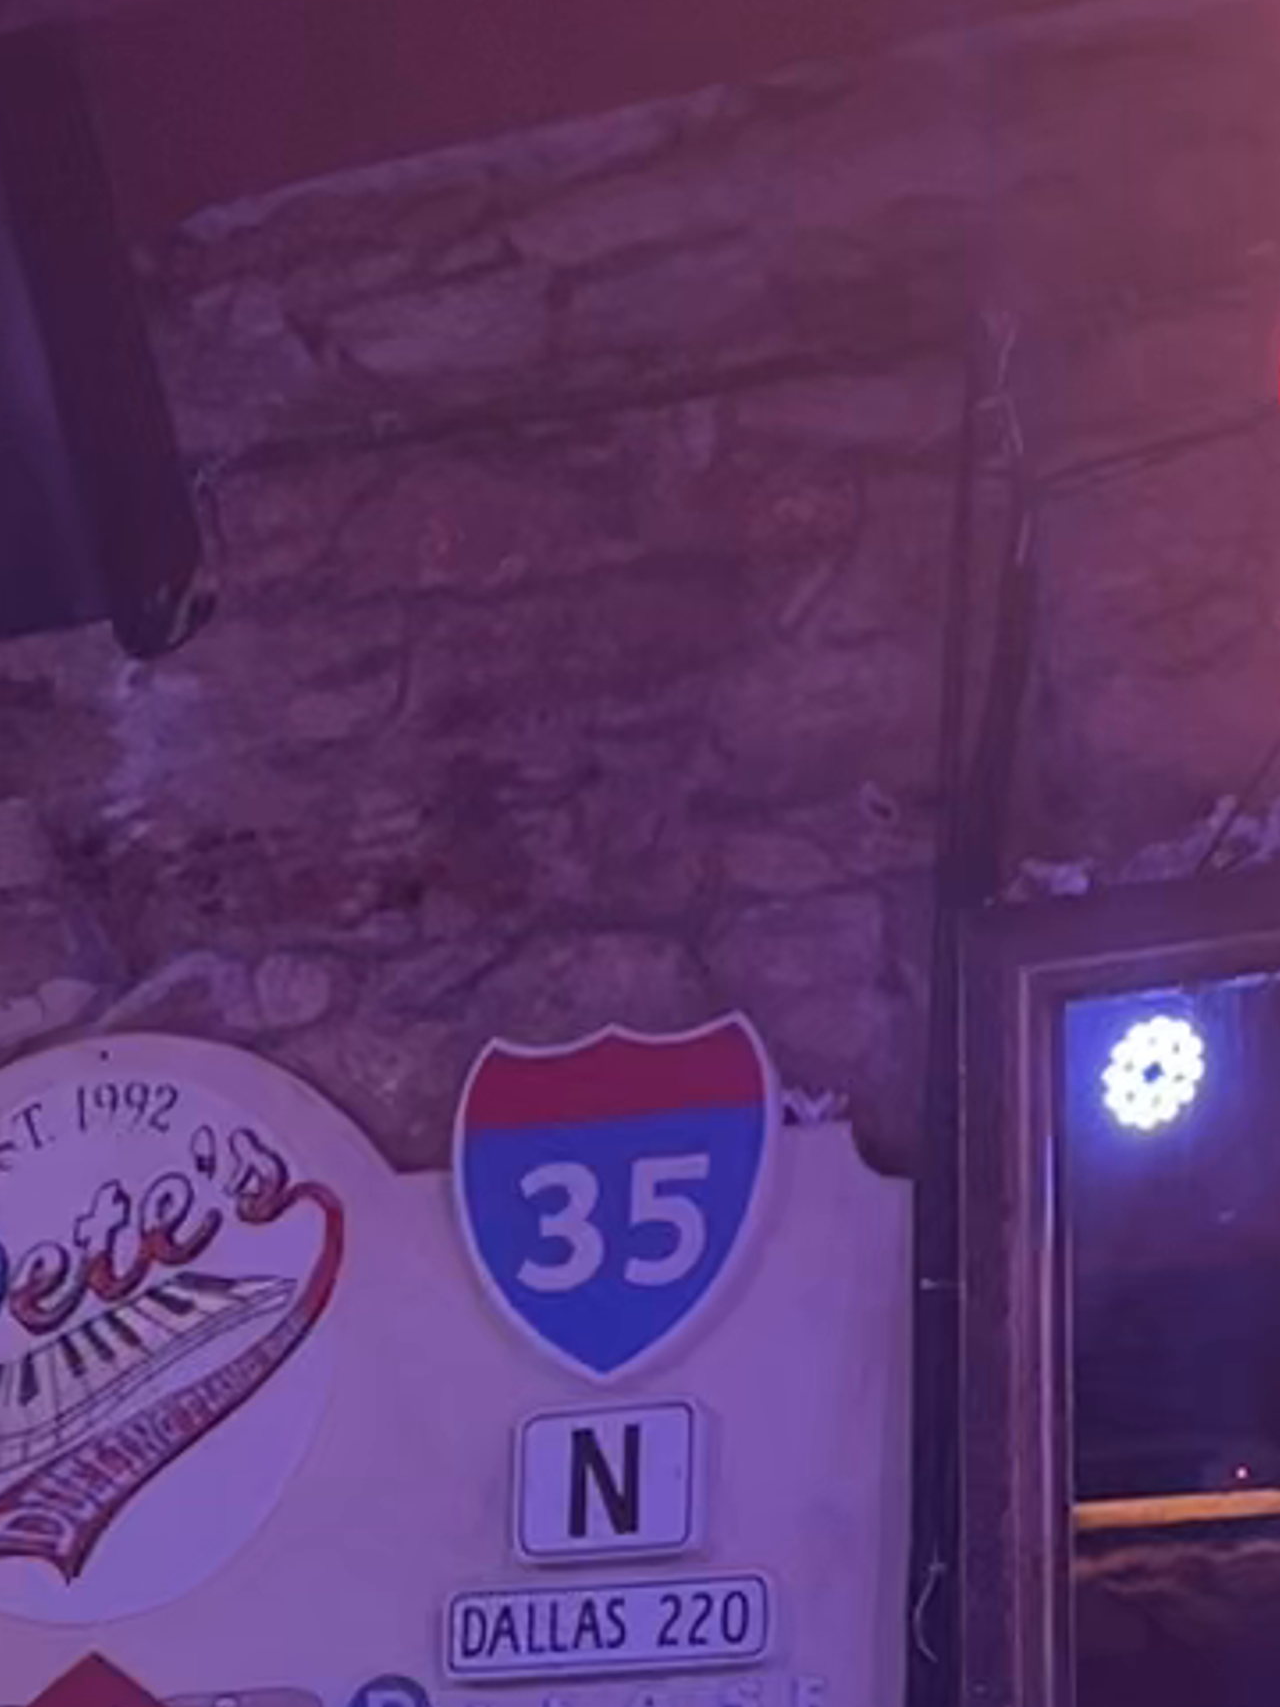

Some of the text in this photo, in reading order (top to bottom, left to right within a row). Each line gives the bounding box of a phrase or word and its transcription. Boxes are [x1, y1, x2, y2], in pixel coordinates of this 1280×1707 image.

[75, 1082, 179, 1134] 1992
[516, 1151, 711, 1294] 35
[566, 1421, 642, 1540] N
[459, 1590, 752, 1661] DALLAS 220
